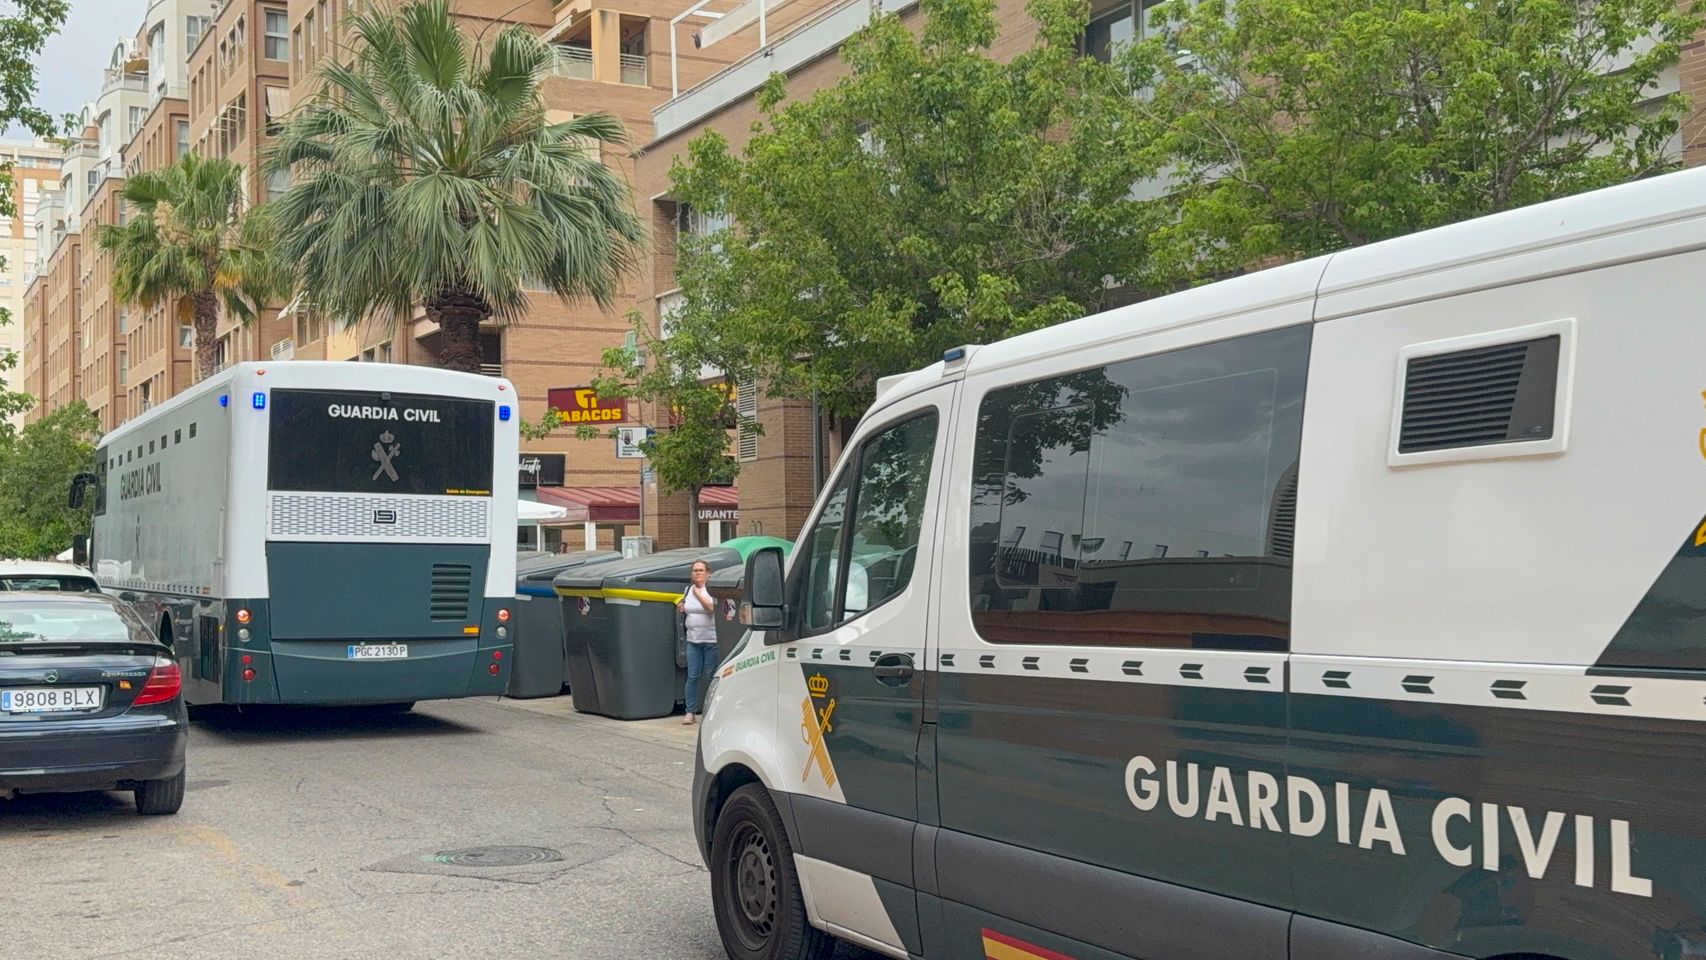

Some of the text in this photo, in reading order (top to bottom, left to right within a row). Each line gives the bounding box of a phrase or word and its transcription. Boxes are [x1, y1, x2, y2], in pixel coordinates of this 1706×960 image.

[328, 404, 441, 423] GUARDIA CIVIL
[121, 462, 161, 501] GUARDIA CIVIL
[354, 647, 373, 657] PGC
[735, 651, 776, 672] GUARDIA CIVIL
[14, 689, 95, 707] 9808 BLX
[1125, 755, 1653, 898] GUARDIA CIVIL
